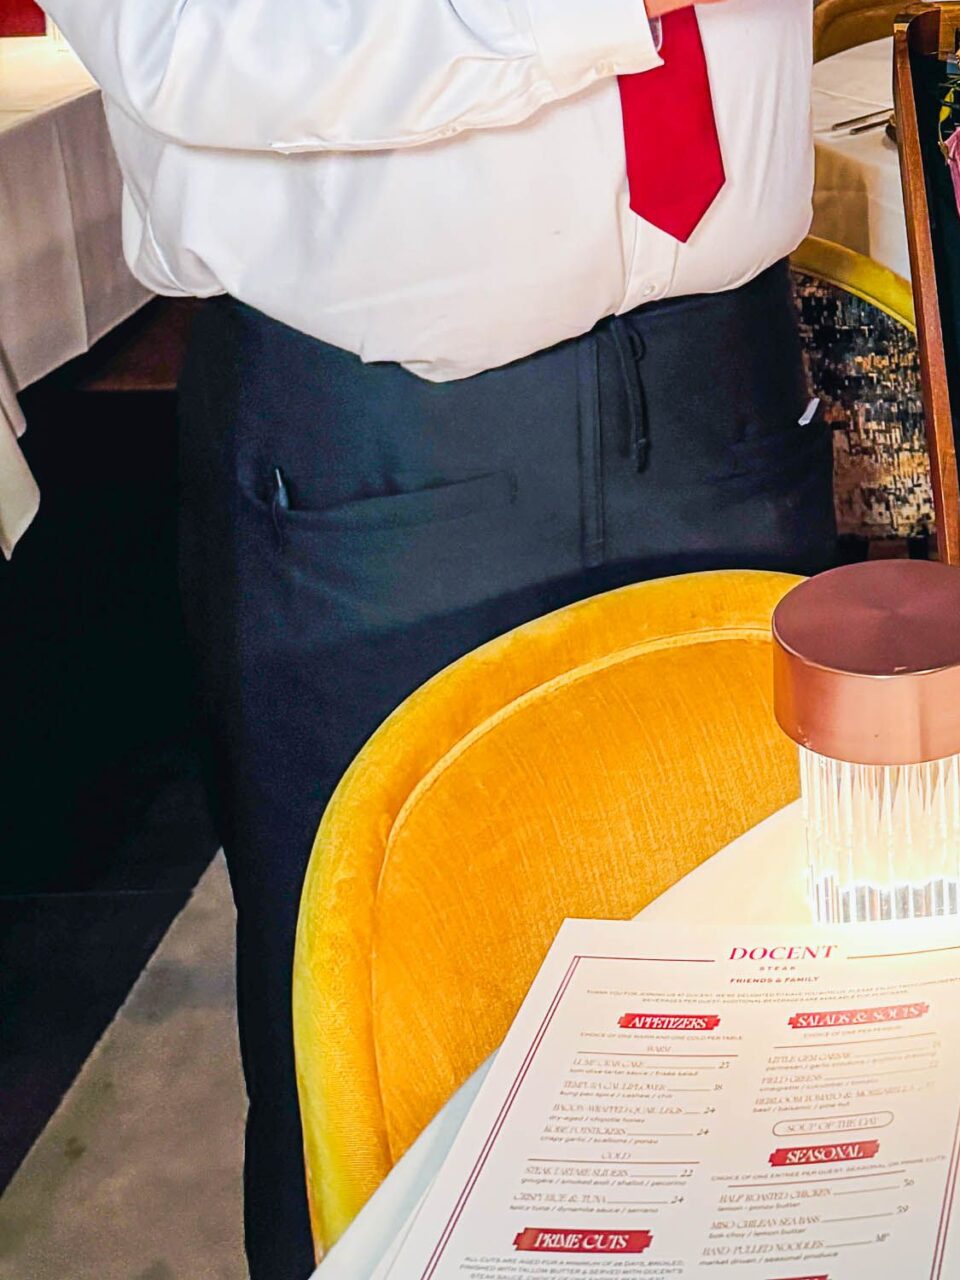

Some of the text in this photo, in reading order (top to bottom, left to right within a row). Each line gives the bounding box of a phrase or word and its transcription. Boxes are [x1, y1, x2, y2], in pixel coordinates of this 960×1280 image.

[729, 945, 837, 960] DOCENT
[628, 1016, 707, 1029] APPETIZERS
[797, 1014, 849, 1027] SALADS
[786, 1144, 864, 1163] SEASONAL
[534, 1232, 630, 1249] PRIME CUTS
